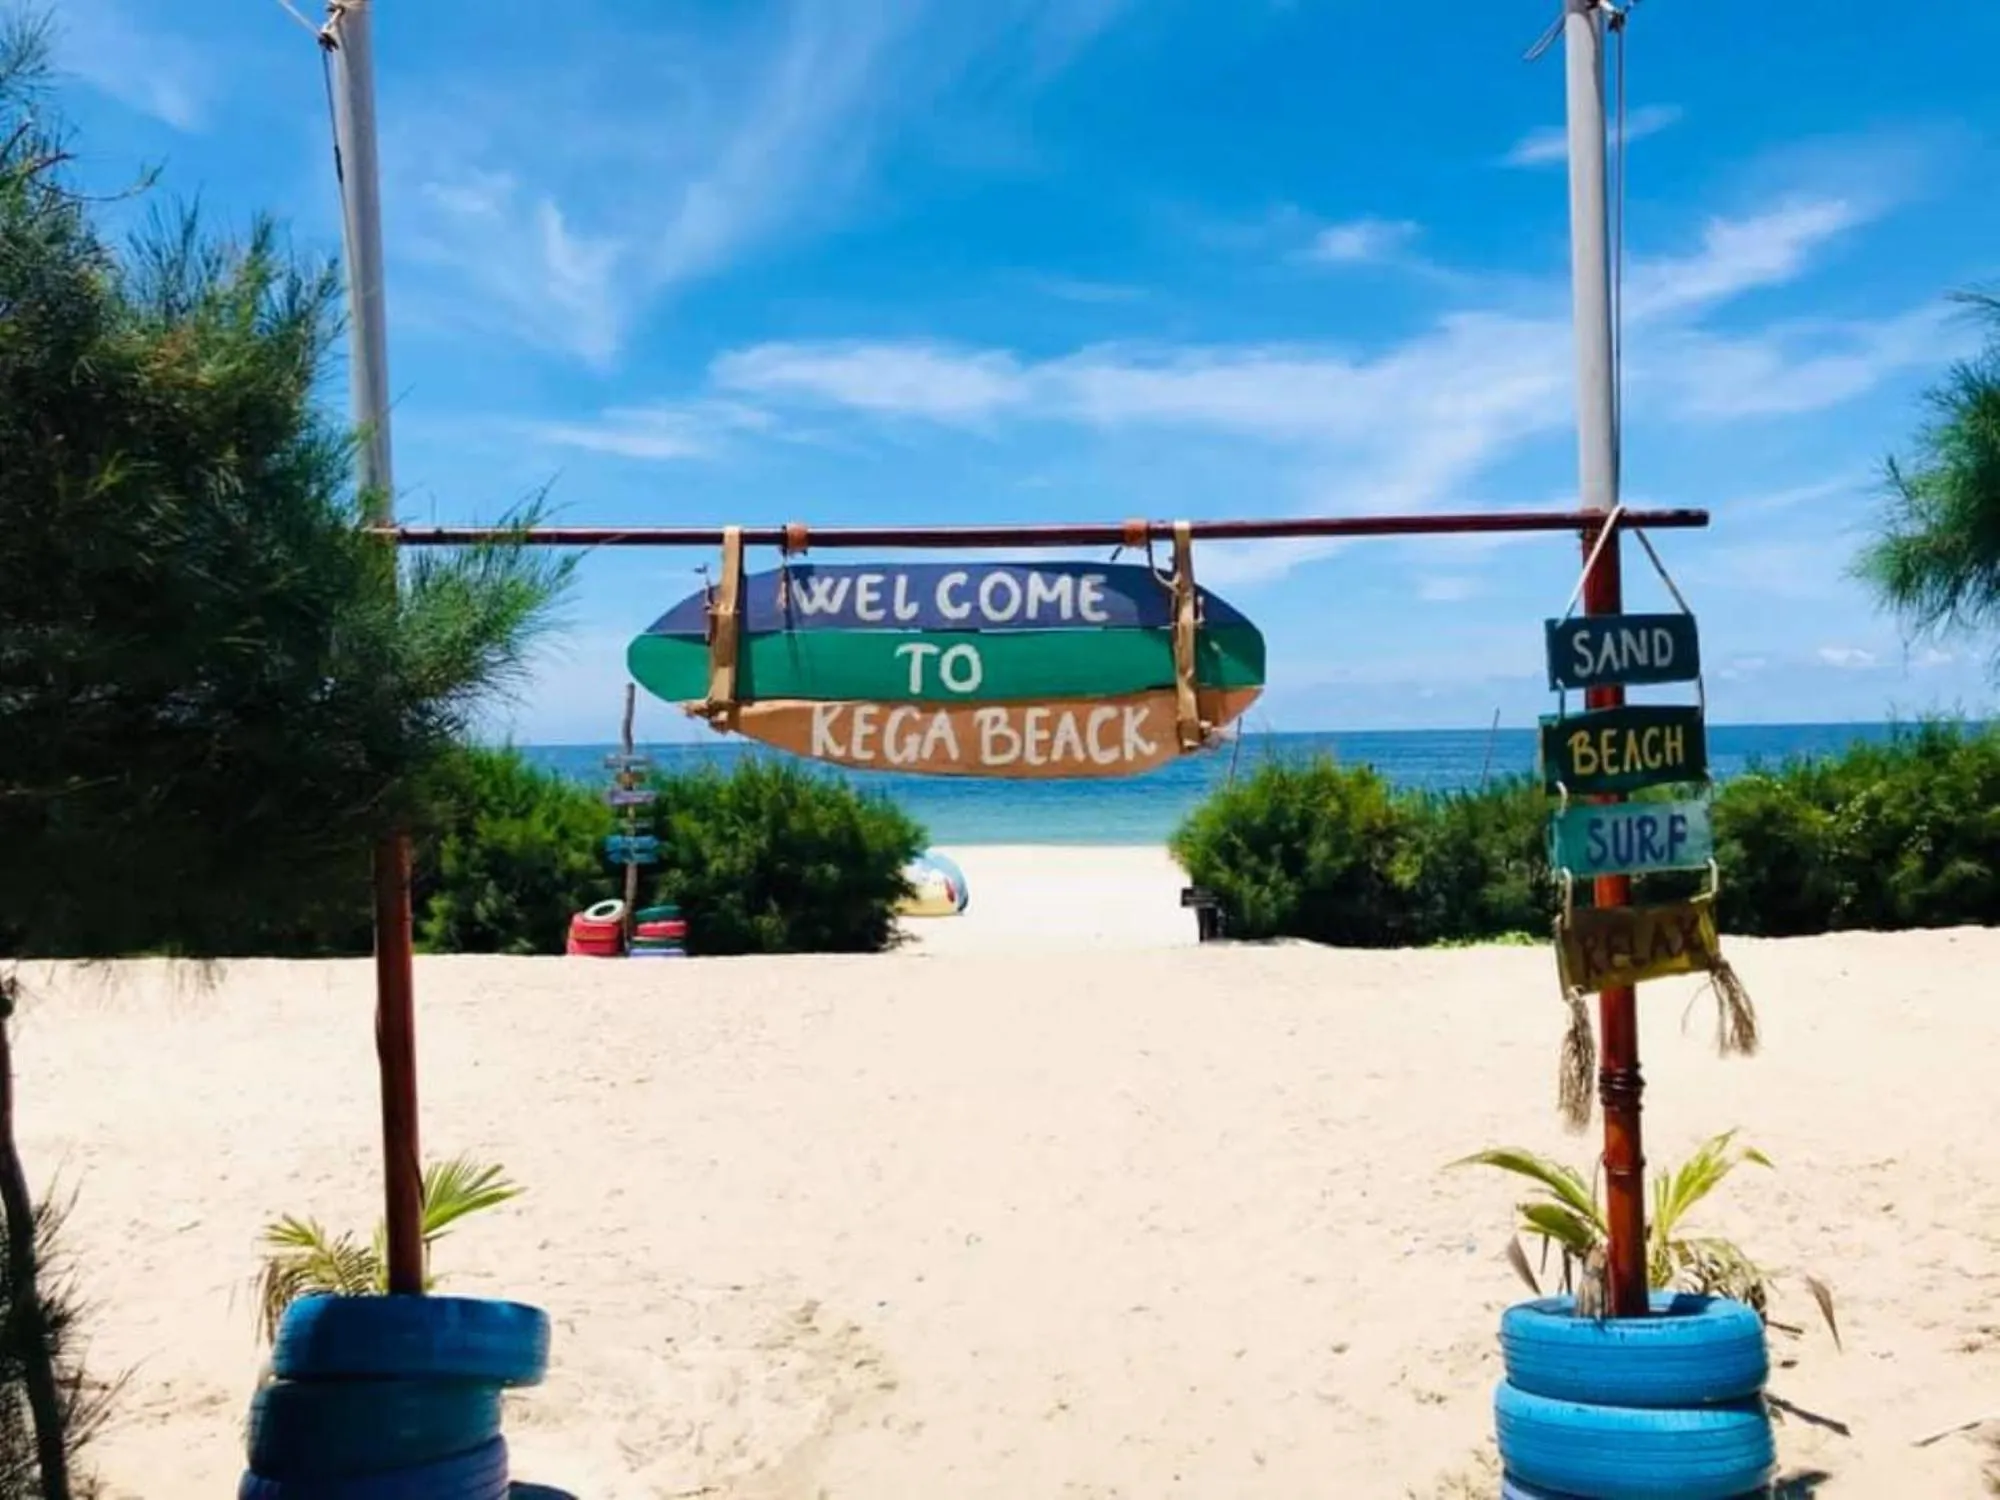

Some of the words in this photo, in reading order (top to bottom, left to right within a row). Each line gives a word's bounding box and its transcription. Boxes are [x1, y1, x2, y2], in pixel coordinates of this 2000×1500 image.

[793, 572, 1108, 621] WELCOME
[894, 643, 981, 693] TO
[1573, 629, 1673, 677] SAND
[812, 703, 959, 761] KEGA
[974, 707, 1156, 765] BEACK
[1568, 726, 1685, 775] BEACH
[1586, 815, 1687, 867] SURF
[1577, 911, 1703, 978] RELAX
